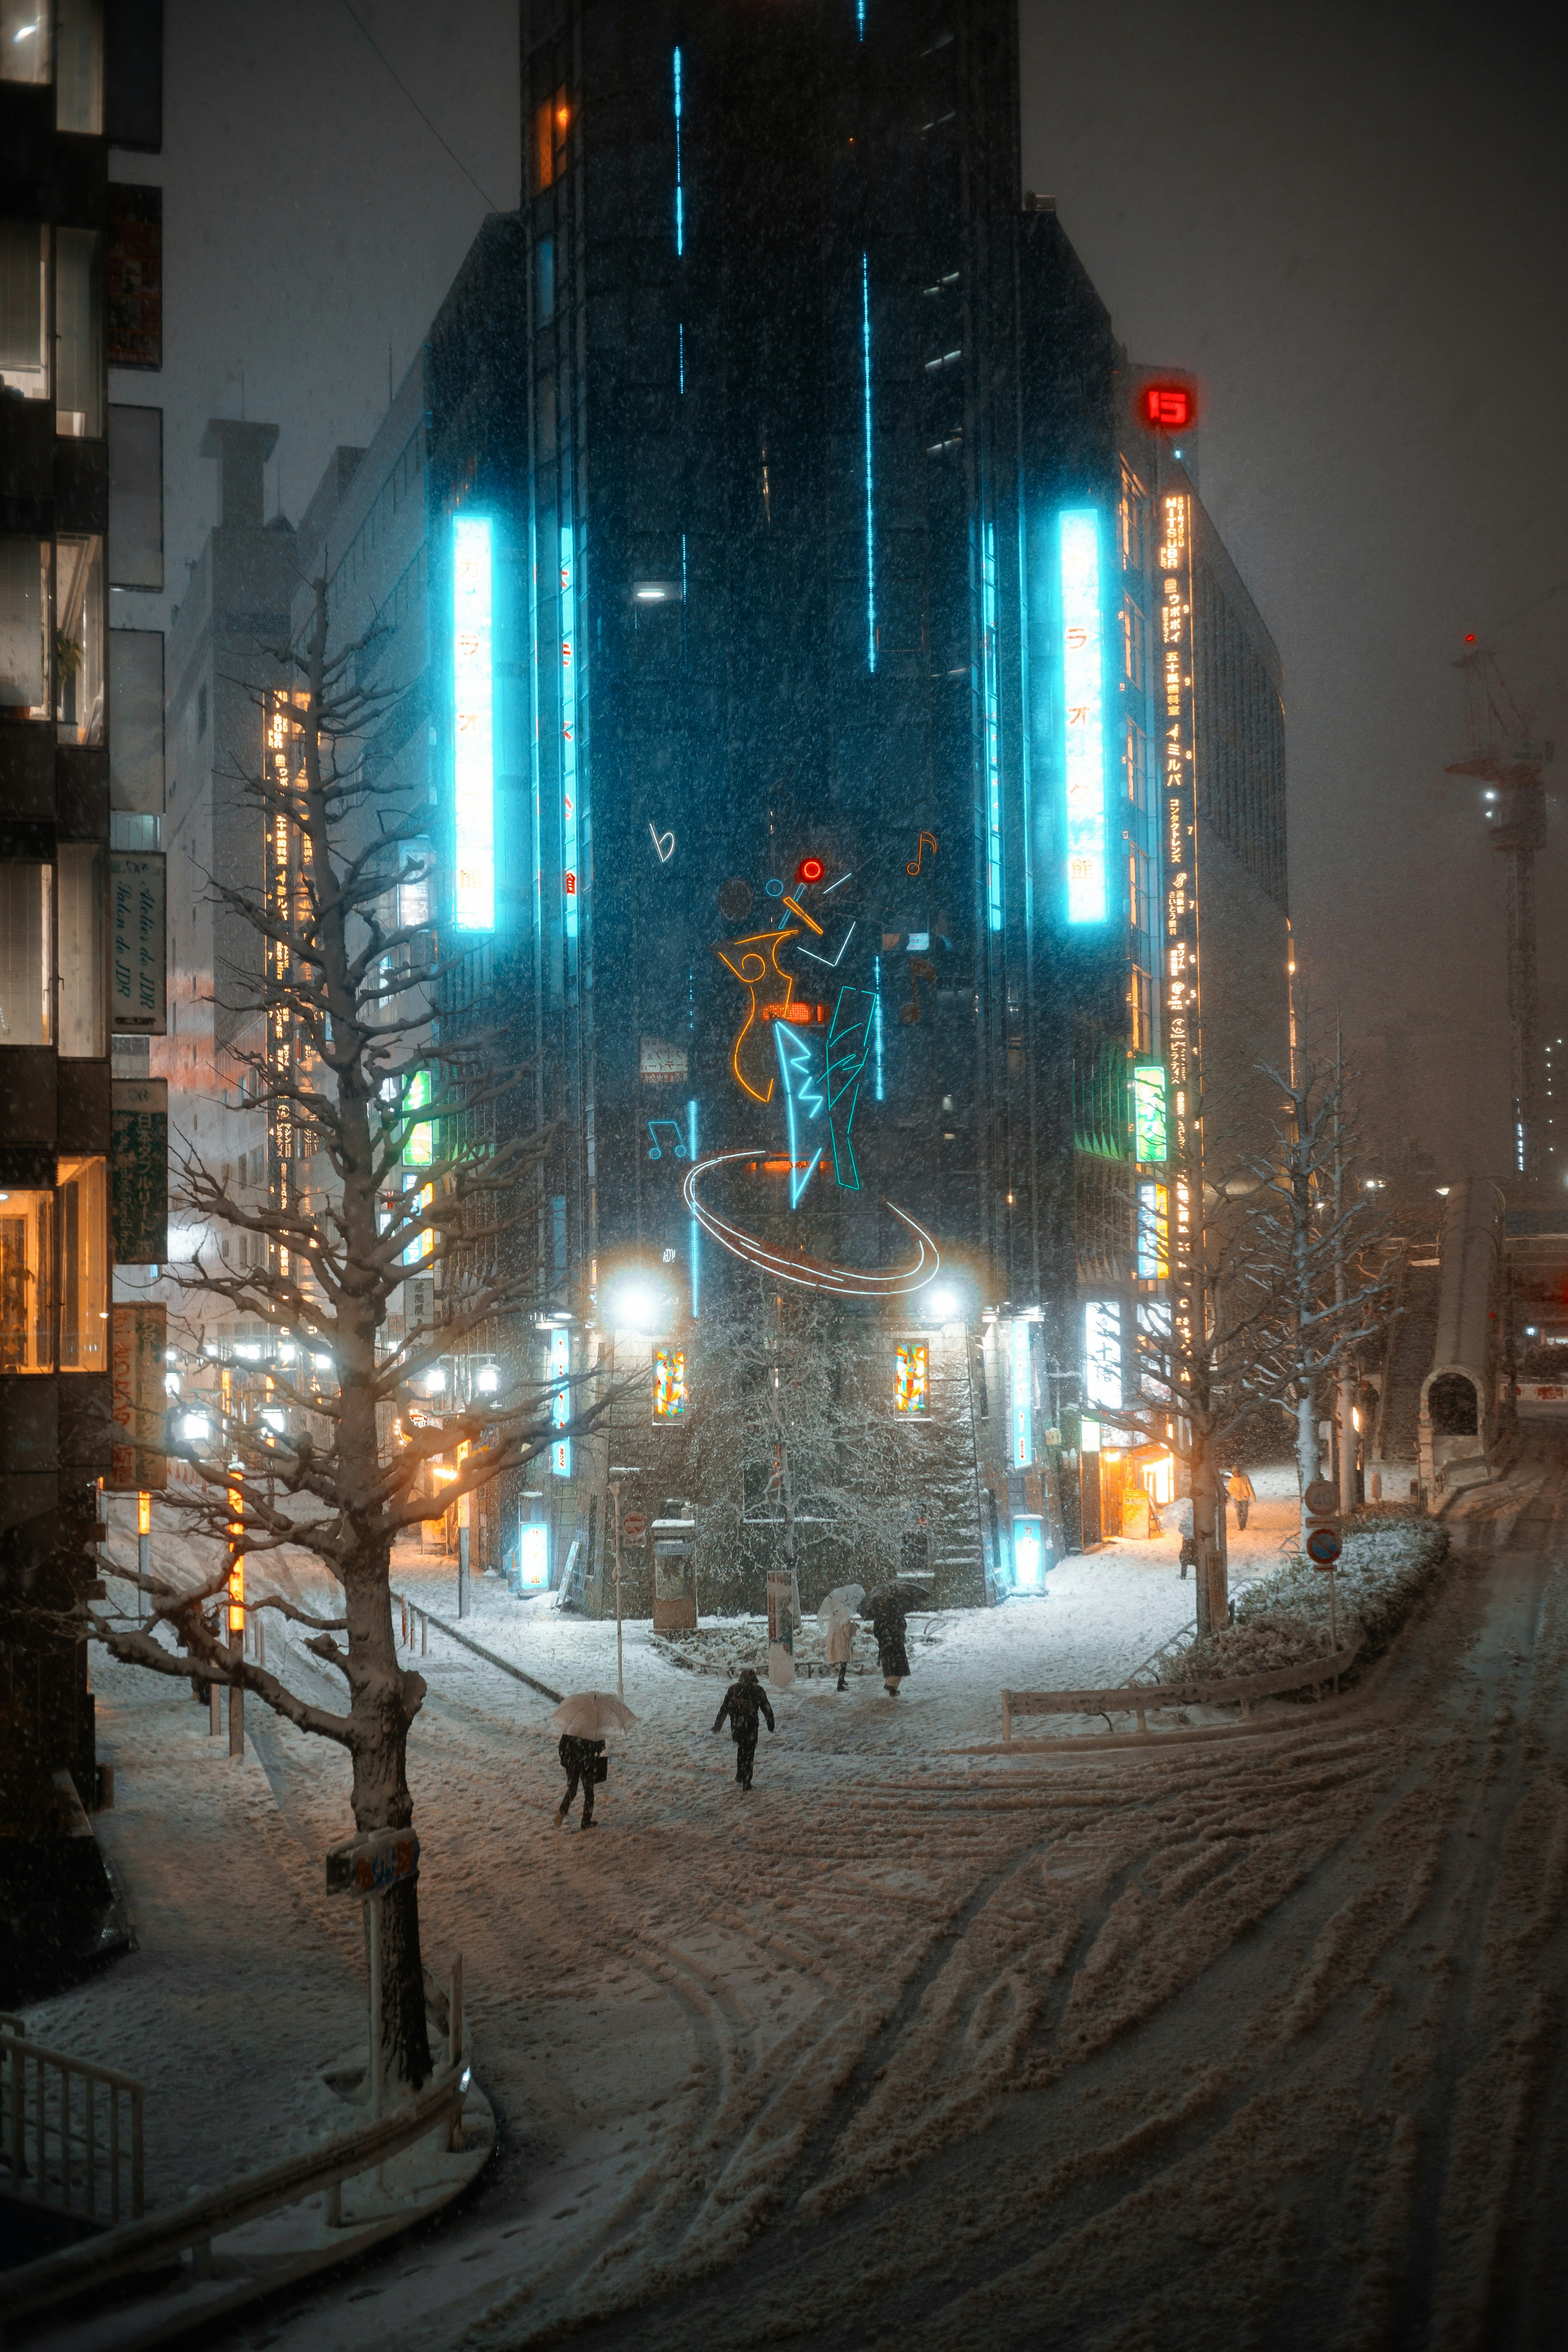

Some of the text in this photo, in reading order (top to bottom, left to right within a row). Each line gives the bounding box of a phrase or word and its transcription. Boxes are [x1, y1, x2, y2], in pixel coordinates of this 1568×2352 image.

[1166, 497, 1178, 569] MITSUBA
[1183, 604, 1189, 614] 9
[1169, 594, 1181, 643] ウポポイ
[1166, 652, 1180, 716] 五十嵐歯科室
[1184, 677, 1191, 686] 9
[1185, 750, 1192, 760] 8
[1167, 743, 1182, 787] ミルバ
[1169, 799, 1181, 863] コンタクトレンズ
[1187, 826, 1193, 835] 7
[267, 834, 272, 842] 9
[401, 901, 428, 913] エース
[1189, 900, 1195, 909] 7
[1168, 891, 1177, 935] さいとう眼科
[116, 935, 130, 955] de
[140, 882, 155, 1010] Atelier de JDR
[268, 952, 273, 960] 7
[1189, 954, 1196, 963] 6
[115, 960, 131, 998] JDR
[1190, 990, 1196, 998] 5
